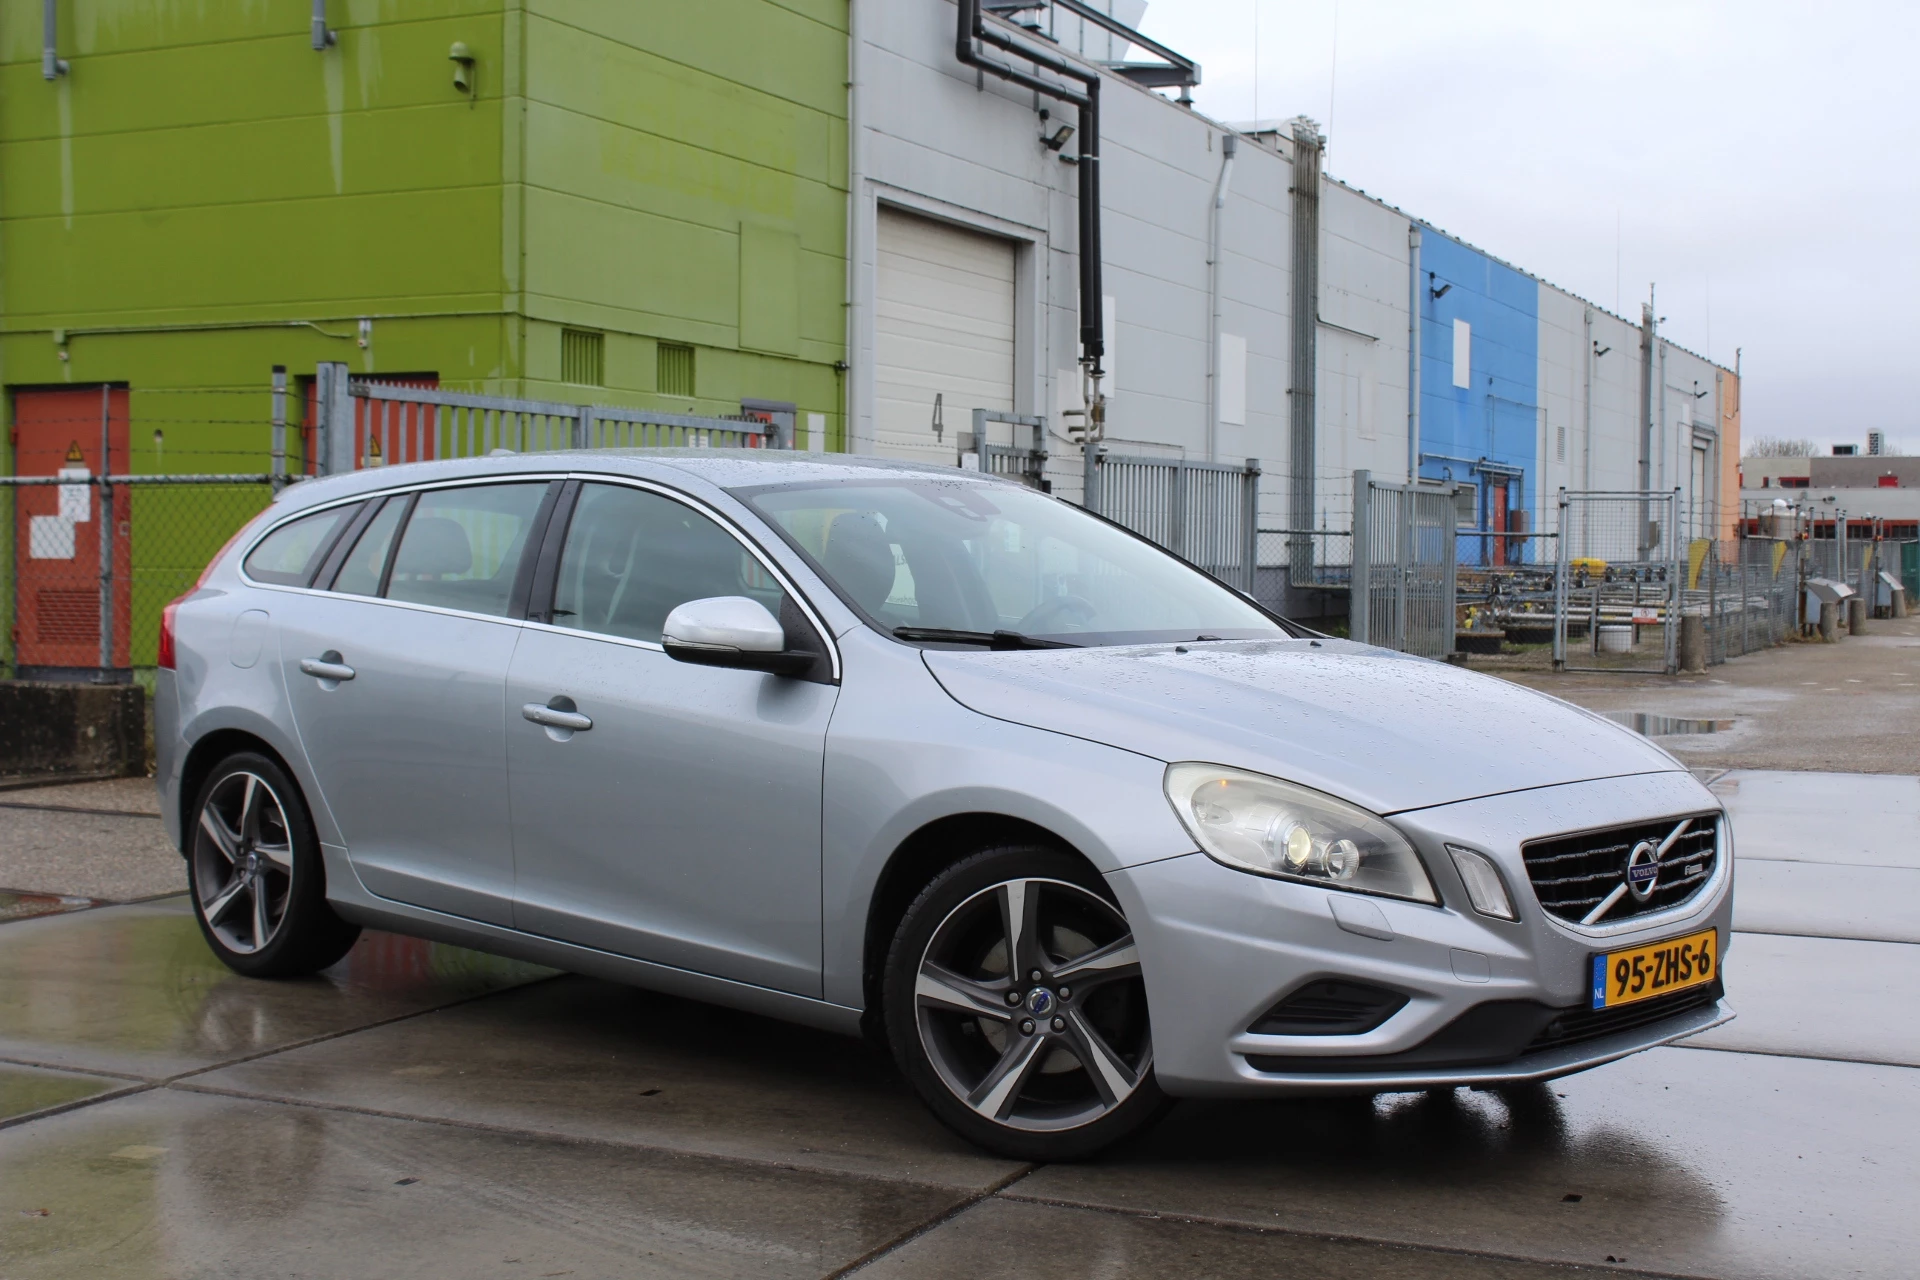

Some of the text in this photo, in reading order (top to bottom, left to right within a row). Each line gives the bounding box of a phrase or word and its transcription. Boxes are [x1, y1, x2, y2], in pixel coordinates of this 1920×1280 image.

[931, 393, 944, 443] 4
[1631, 866, 1658, 878] VOLVO
[1615, 939, 1711, 998] 95-ZHS-6
[1594, 987, 1604, 1000] NL
